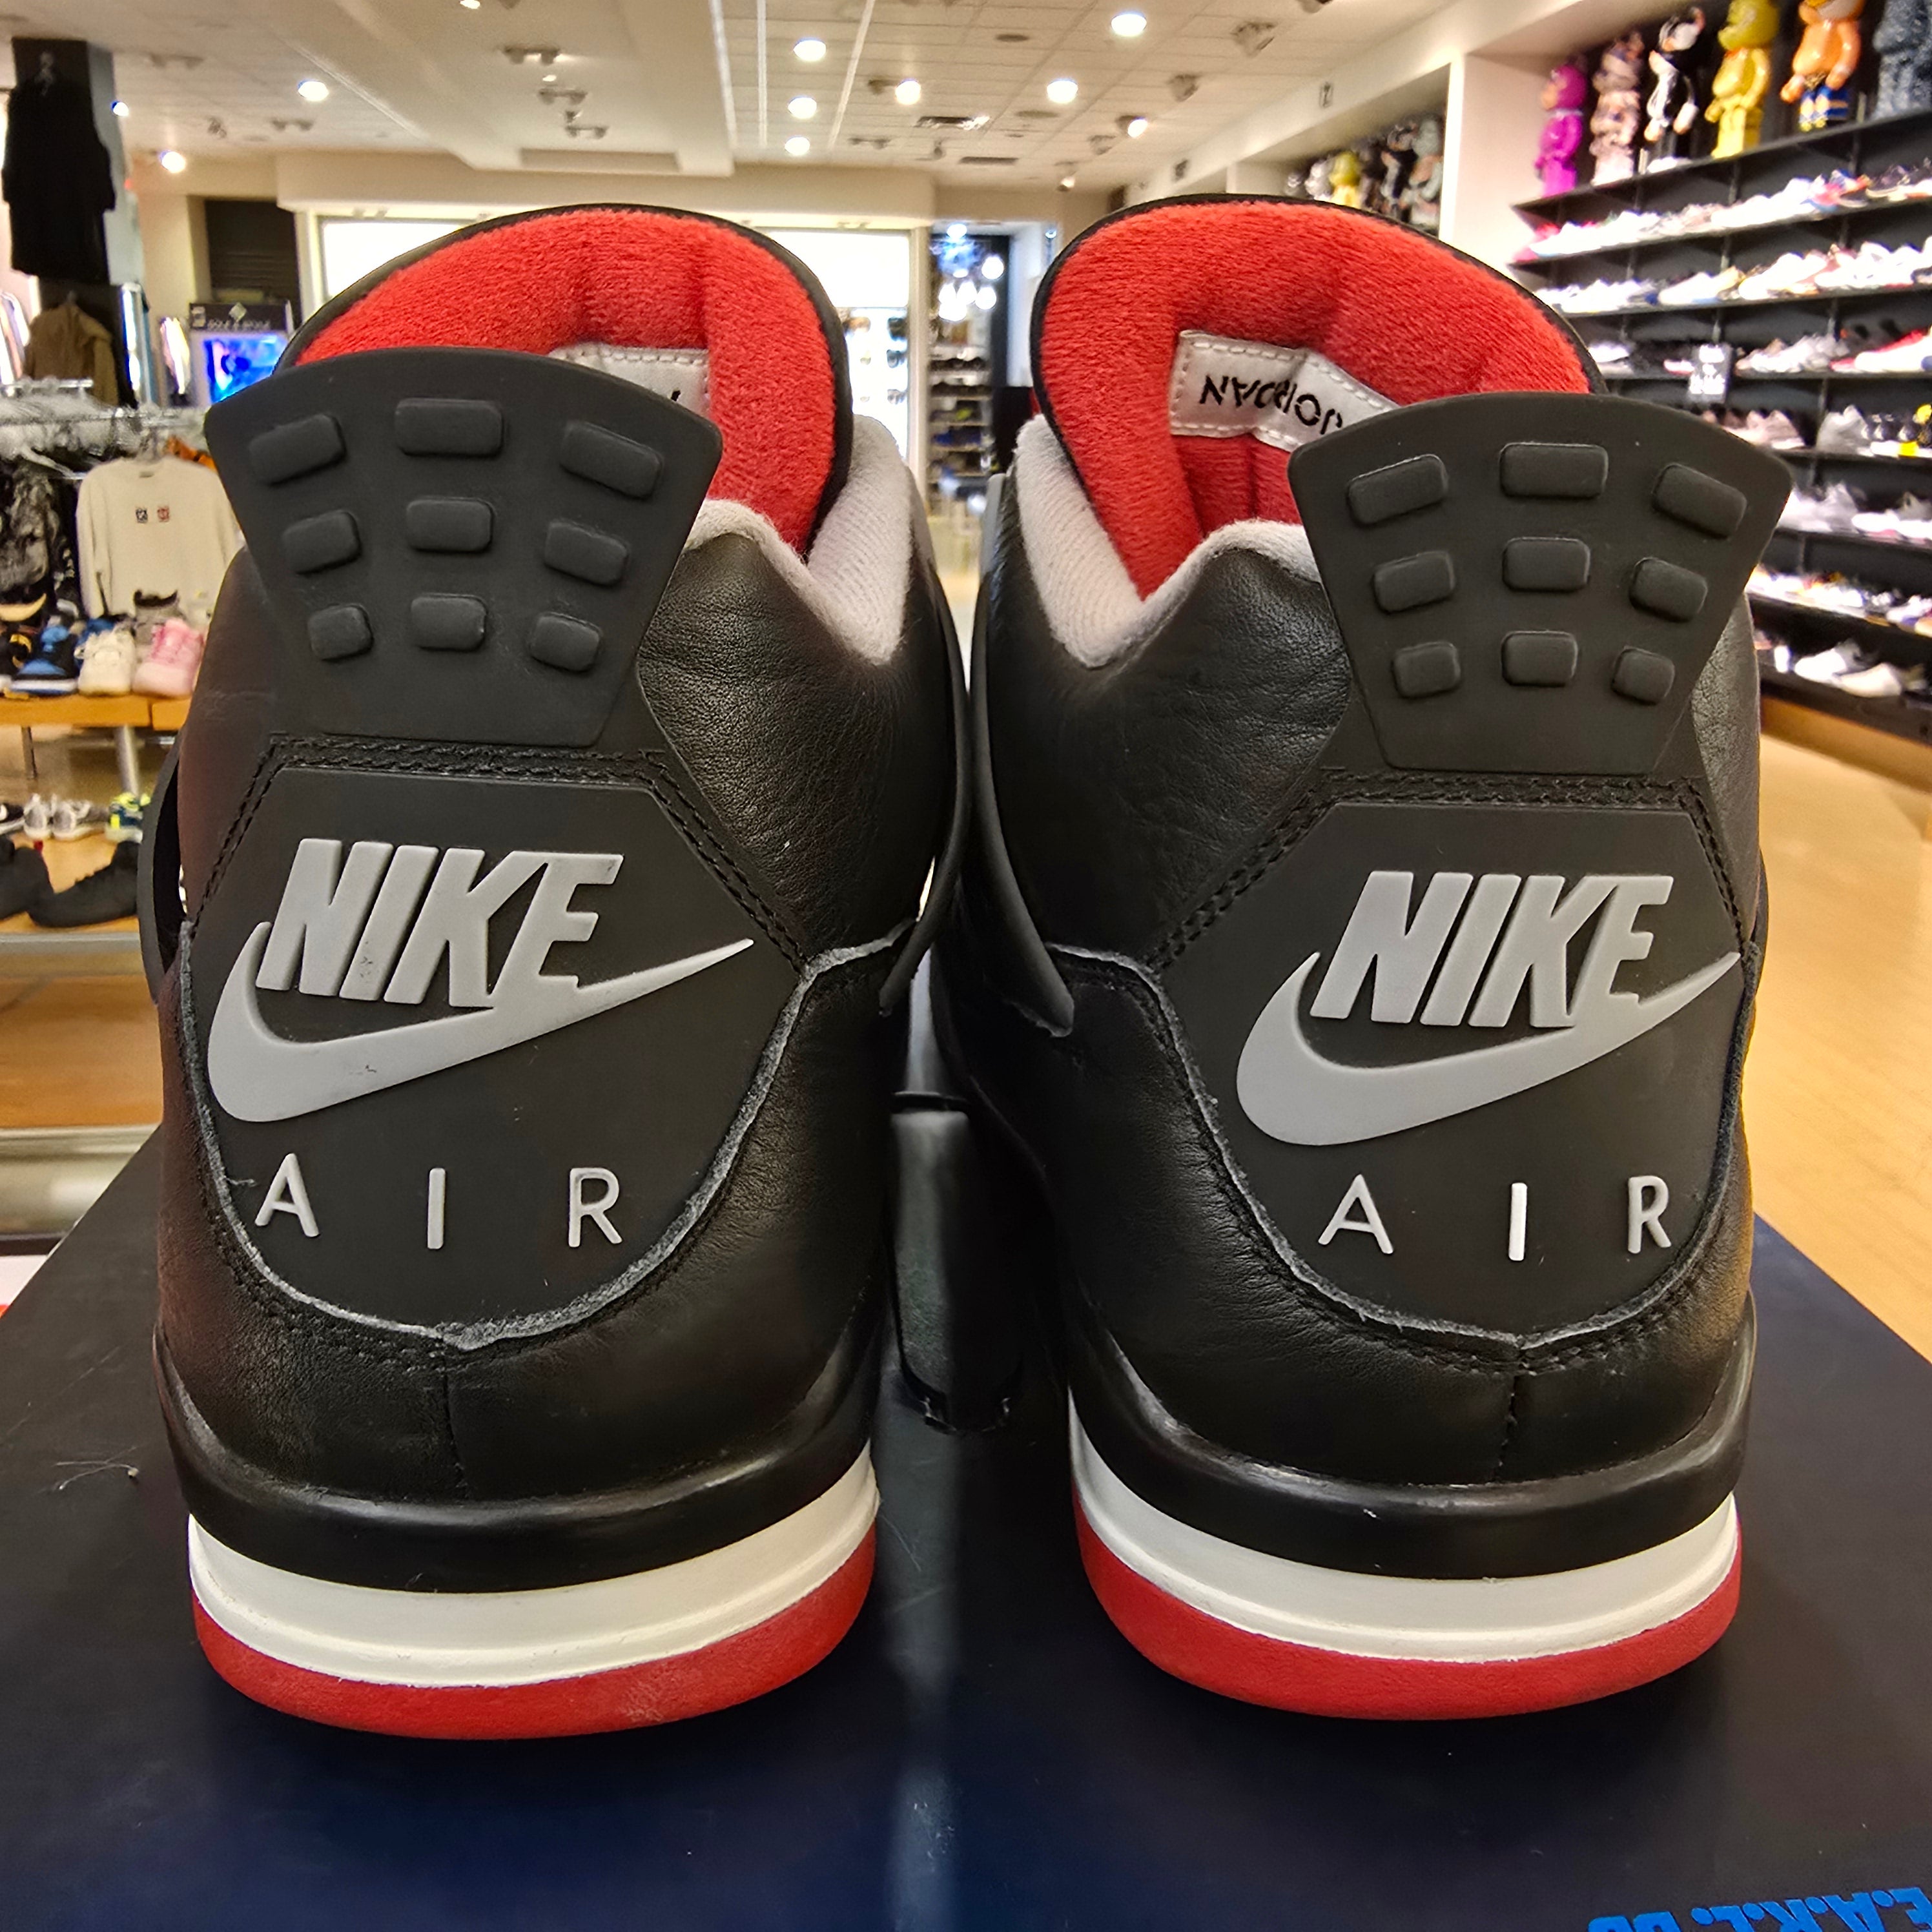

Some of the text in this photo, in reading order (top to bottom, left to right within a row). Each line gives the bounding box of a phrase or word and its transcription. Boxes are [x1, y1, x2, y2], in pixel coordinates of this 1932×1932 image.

[255, 838, 624, 1009] NIKE
[1310, 870, 1674, 1028] NIKE
[254, 1153, 622, 1250] AIR
[1317, 1173, 1672, 1262] AIR
